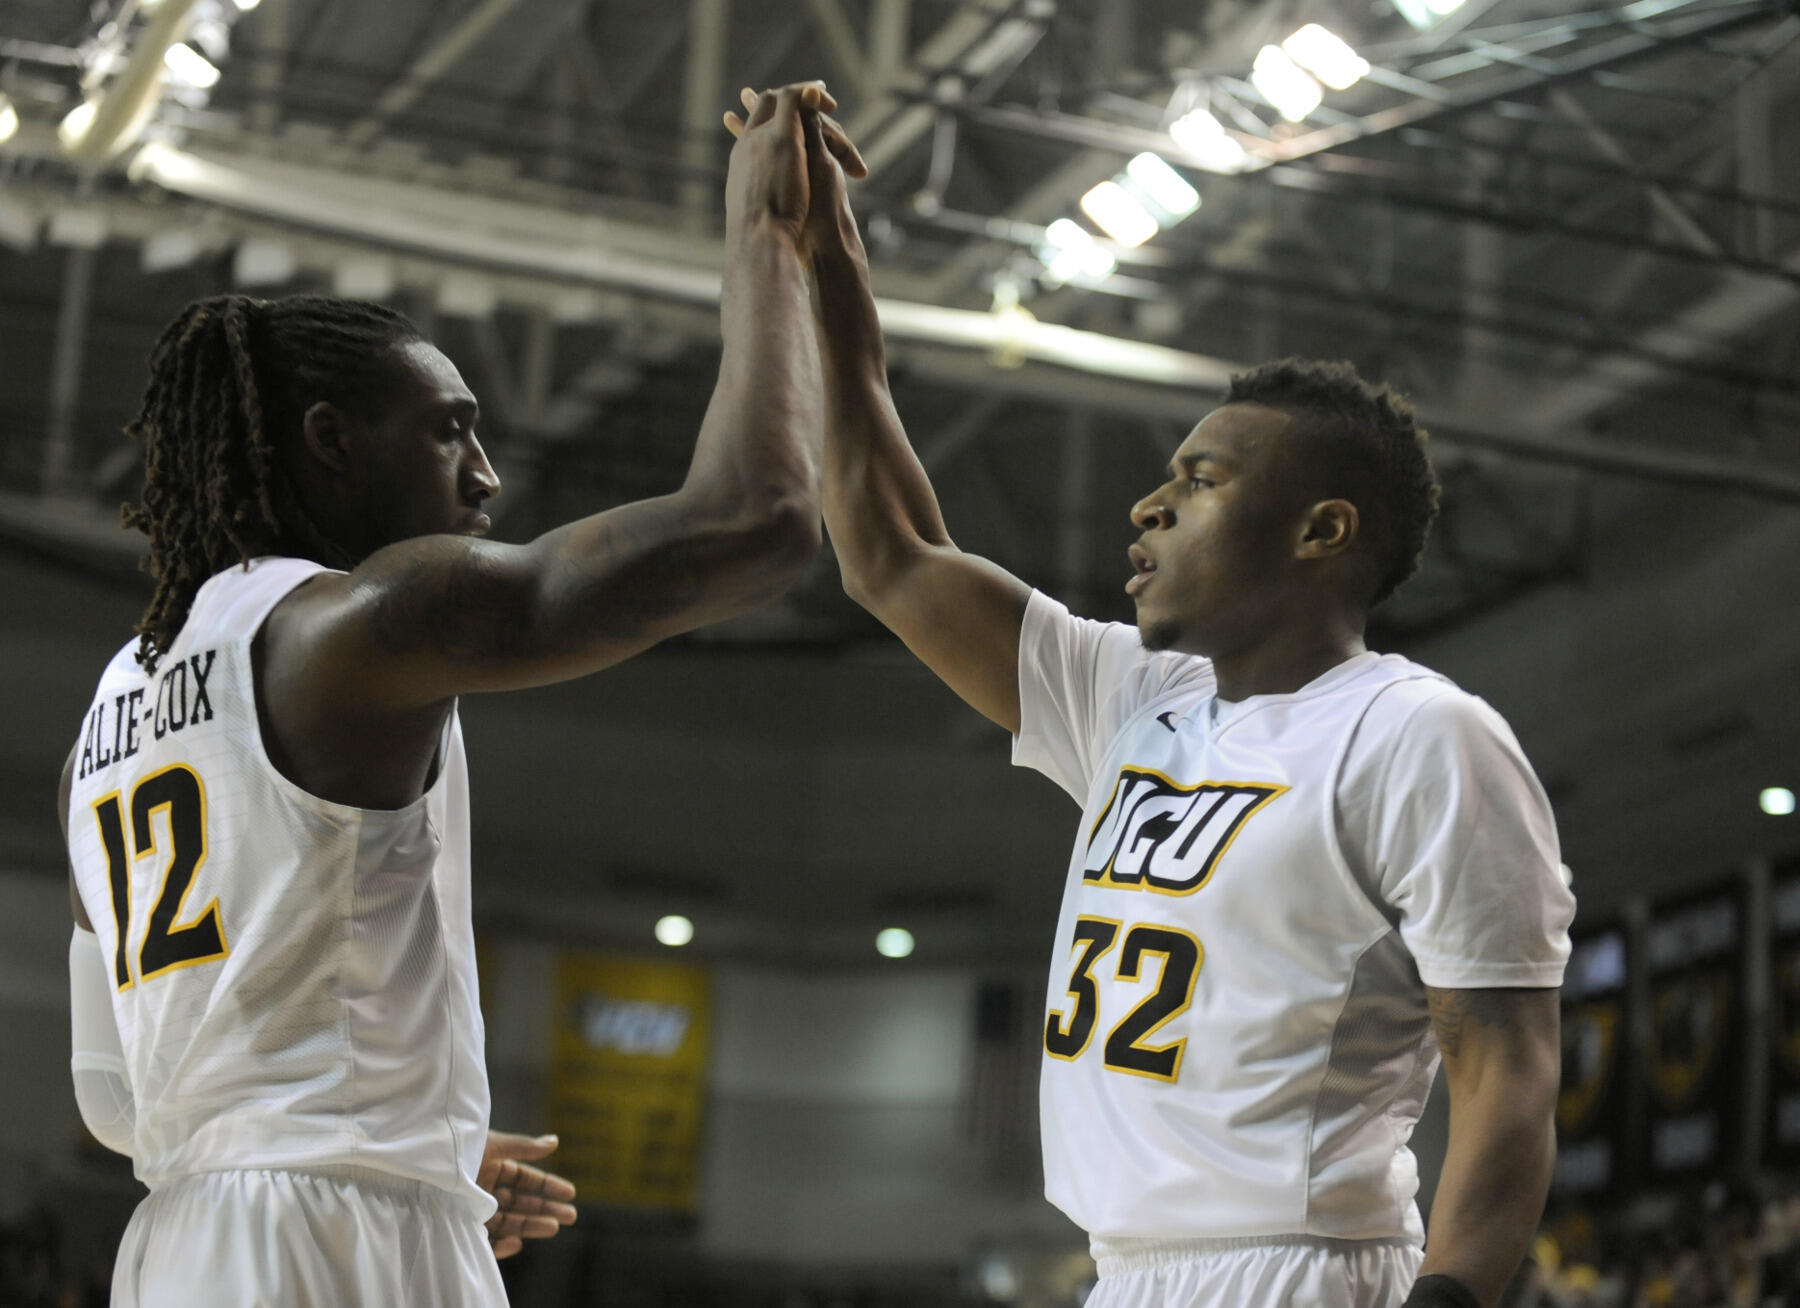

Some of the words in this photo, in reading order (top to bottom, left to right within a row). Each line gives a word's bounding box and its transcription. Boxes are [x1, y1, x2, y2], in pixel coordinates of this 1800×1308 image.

[79, 649, 216, 780] ALIE-COX
[90, 762, 230, 993] 12
[1044, 914, 1204, 1084] 32
